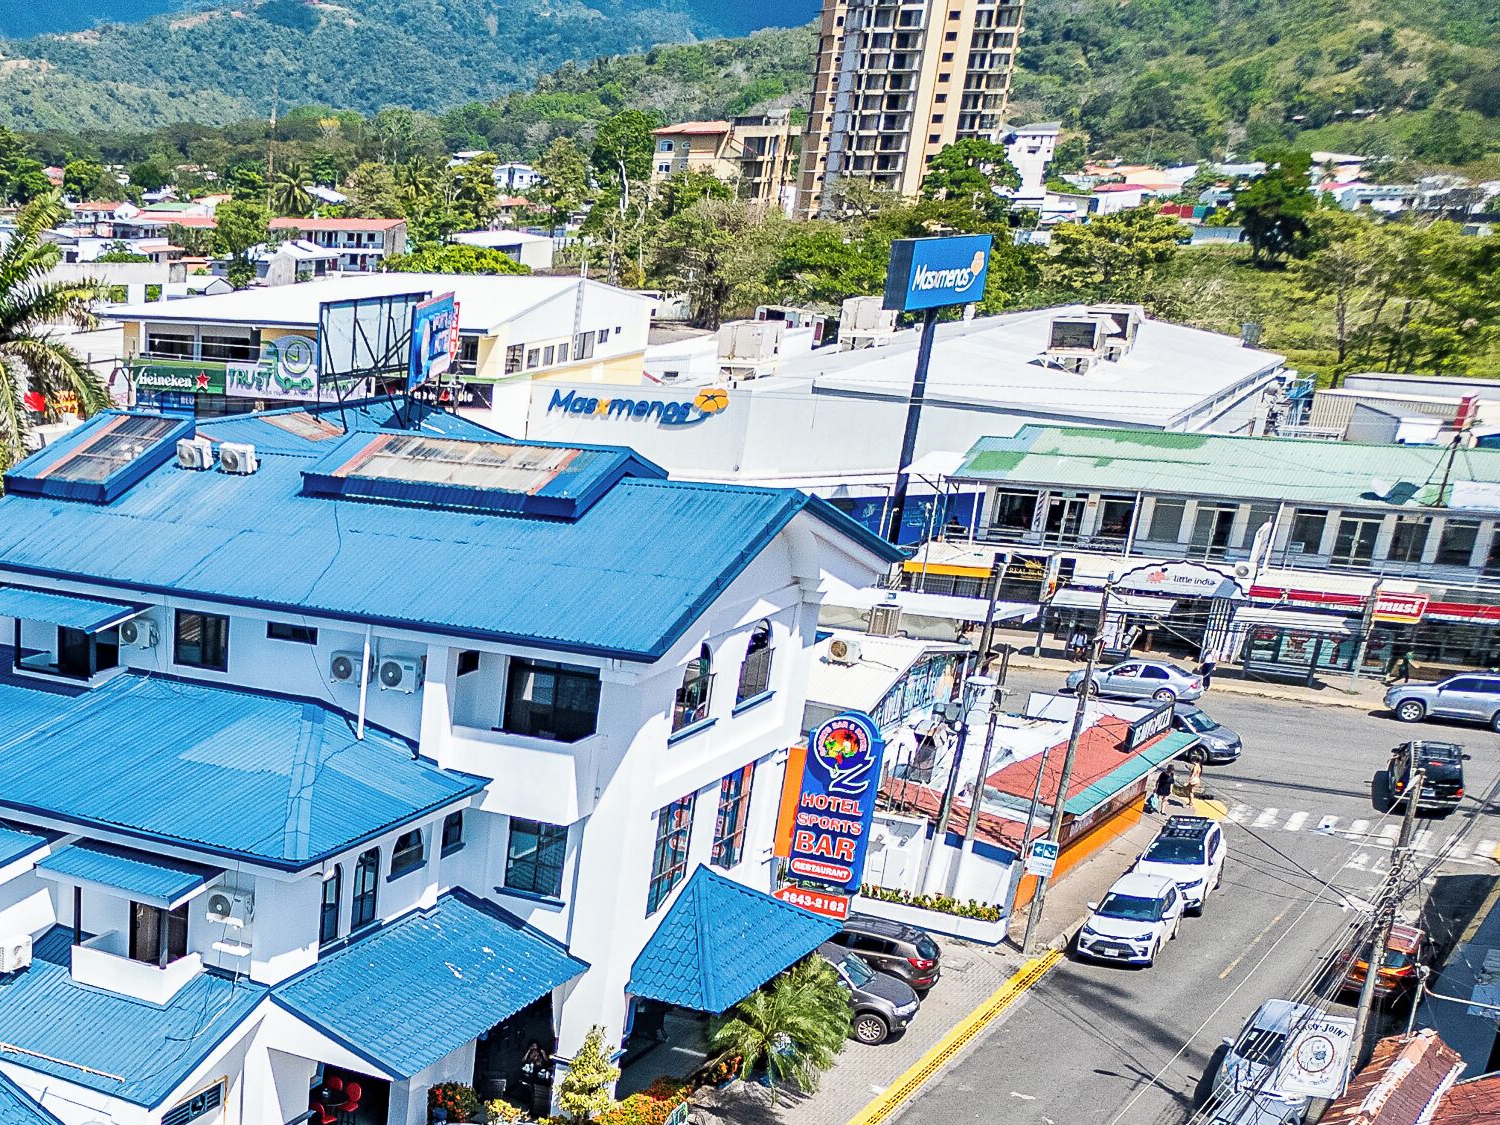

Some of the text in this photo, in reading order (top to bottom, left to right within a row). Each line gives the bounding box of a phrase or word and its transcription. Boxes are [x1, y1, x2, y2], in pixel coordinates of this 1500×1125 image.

[137, 369, 193, 388] Heineken
[228, 367, 273, 390] TRUST
[548, 388, 694, 423] Masxmenos
[1173, 575, 1216, 586] little india
[801, 792, 863, 816] HOTEL
[797, 812, 862, 835] SPORTS
[794, 830, 856, 862] BAR
[793, 861, 849, 879] RESTAURANT
